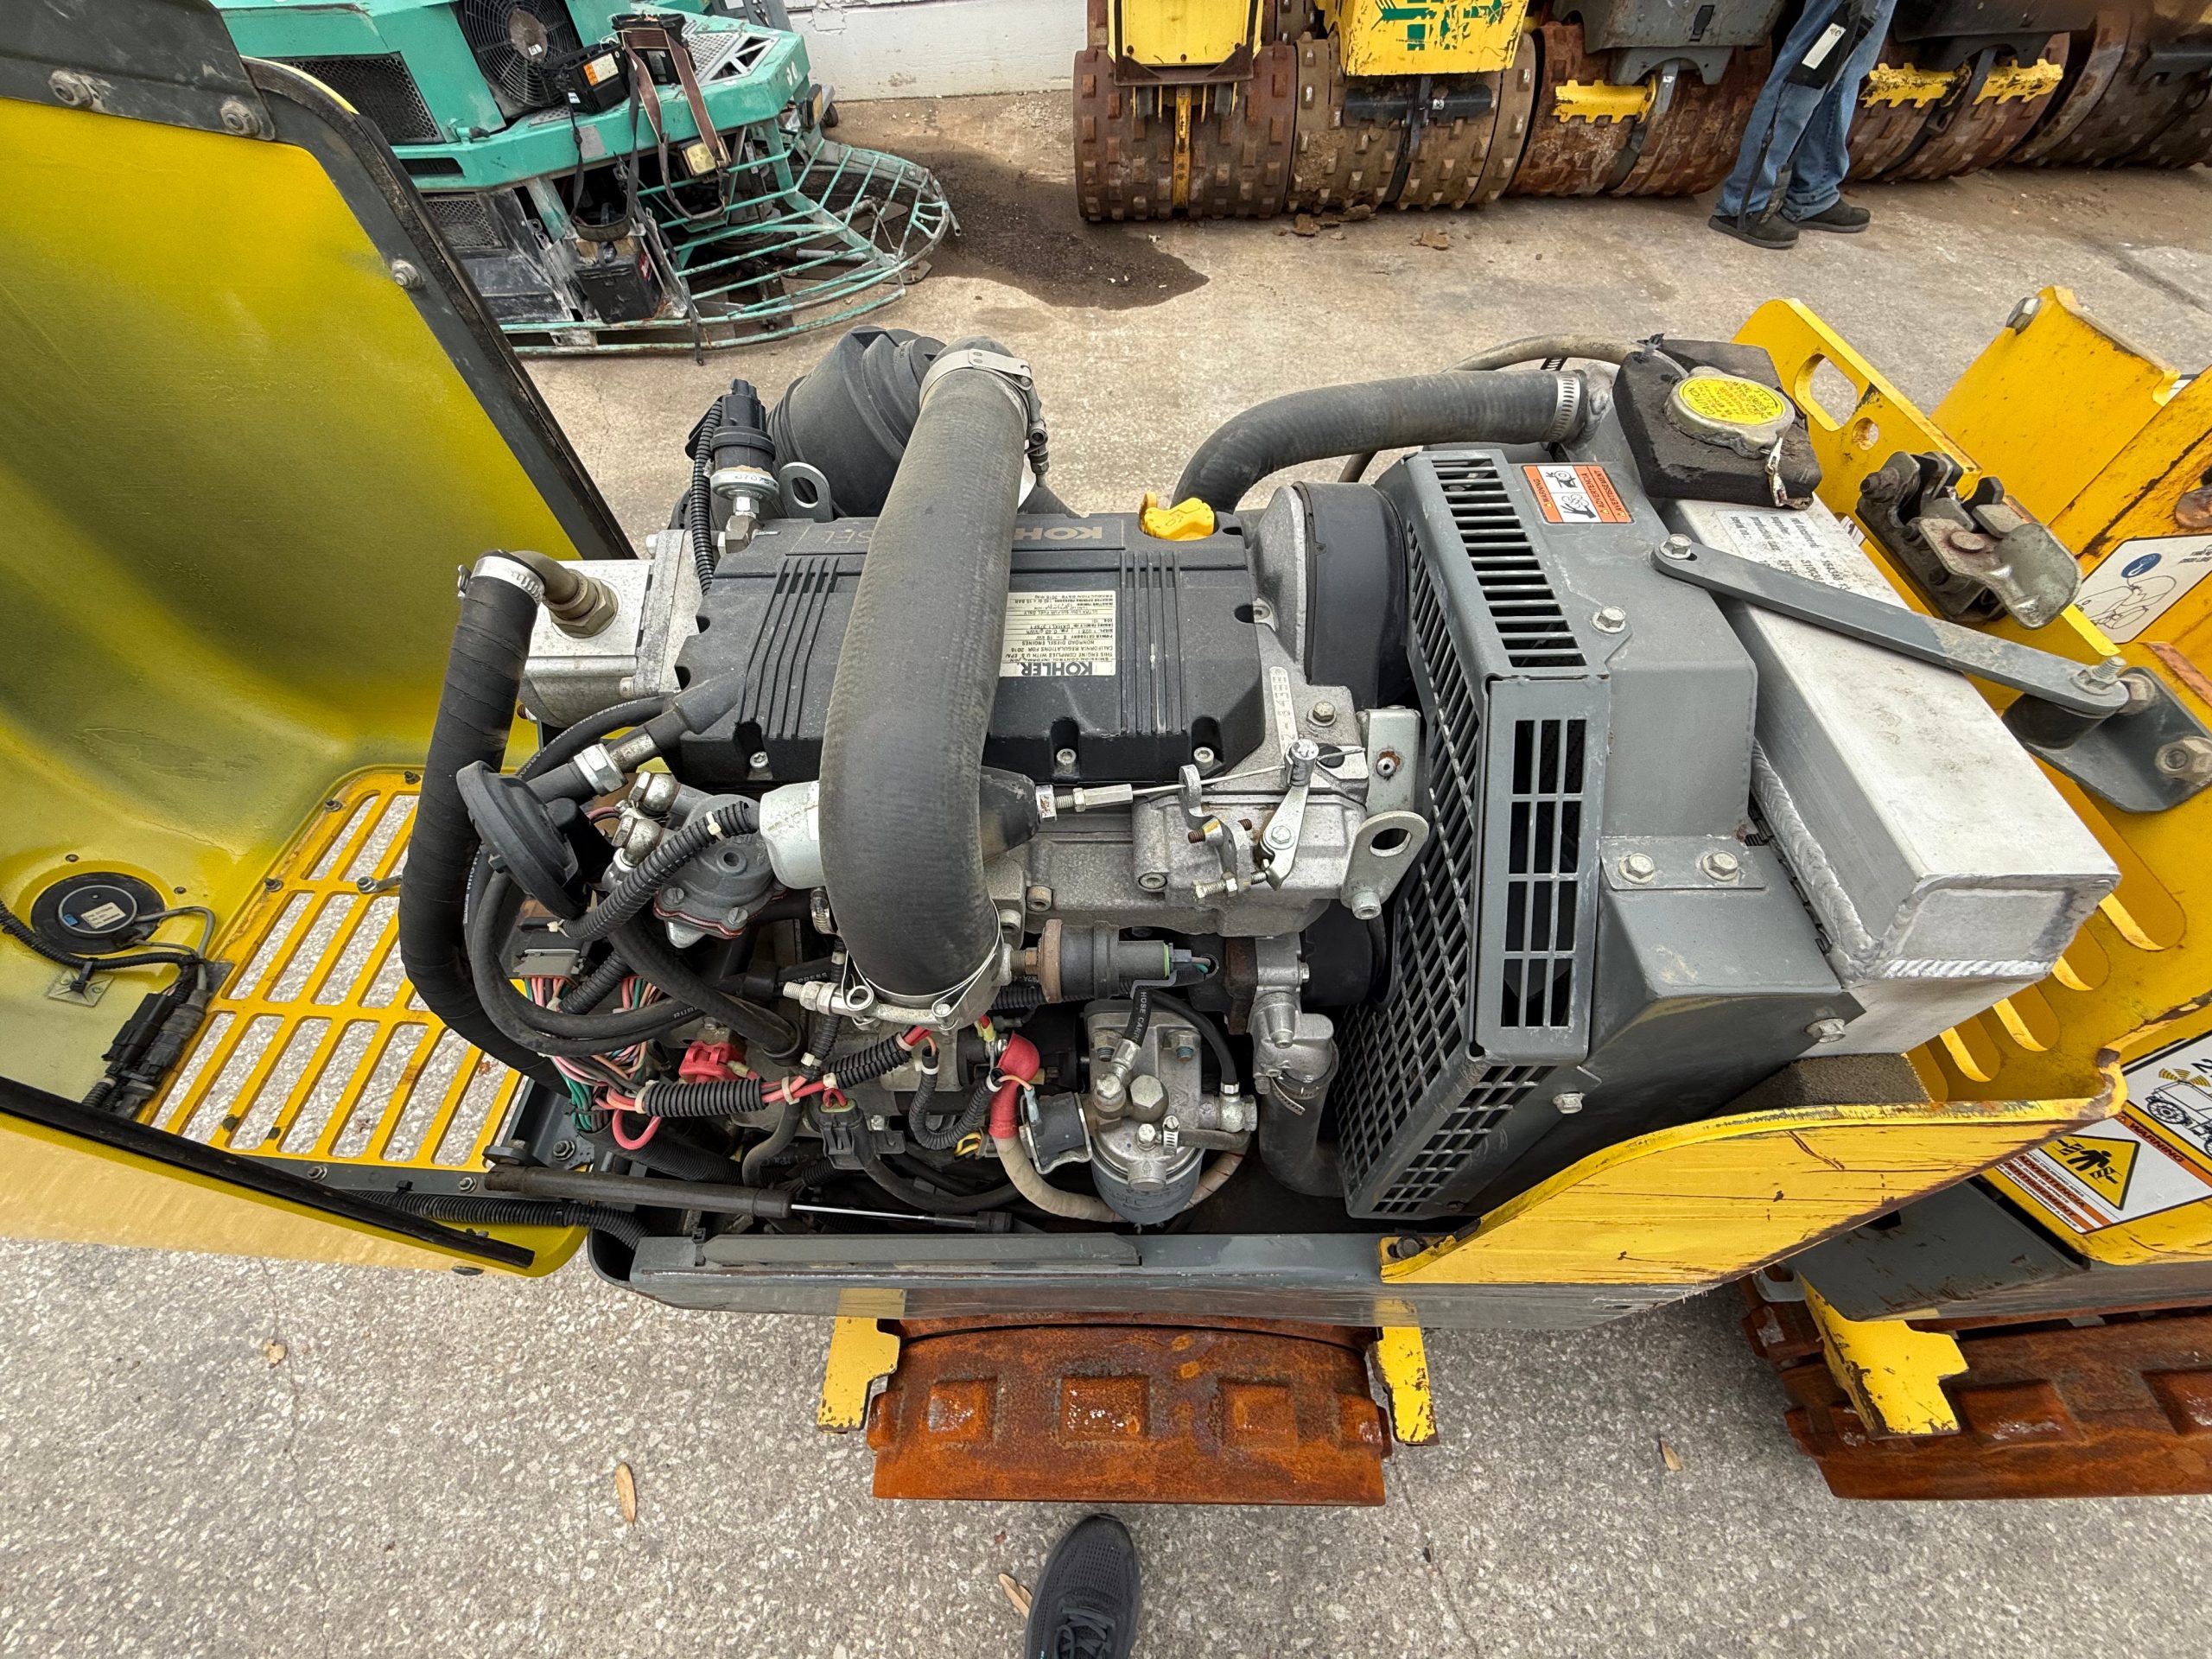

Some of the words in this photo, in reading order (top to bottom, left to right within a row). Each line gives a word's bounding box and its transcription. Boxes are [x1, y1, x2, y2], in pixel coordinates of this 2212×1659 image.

[1533, 479, 1548, 505] WARNING
[1580, 473, 1605, 508] ADVERTENCIA
[1593, 470, 1623, 511] AVERTISSEMENT
[822, 529, 873, 545] SEL
[1013, 525, 1103, 540] KOH
[2128, 1122, 2185, 1163] WARNING
[2003, 1160, 2078, 1217] VERTISSEMENT
[2018, 1154, 2086, 1208] ADVERTENCIA
[2039, 1162, 2070, 1185] CRUSHING
[2068, 1185, 2085, 1198] AREA
